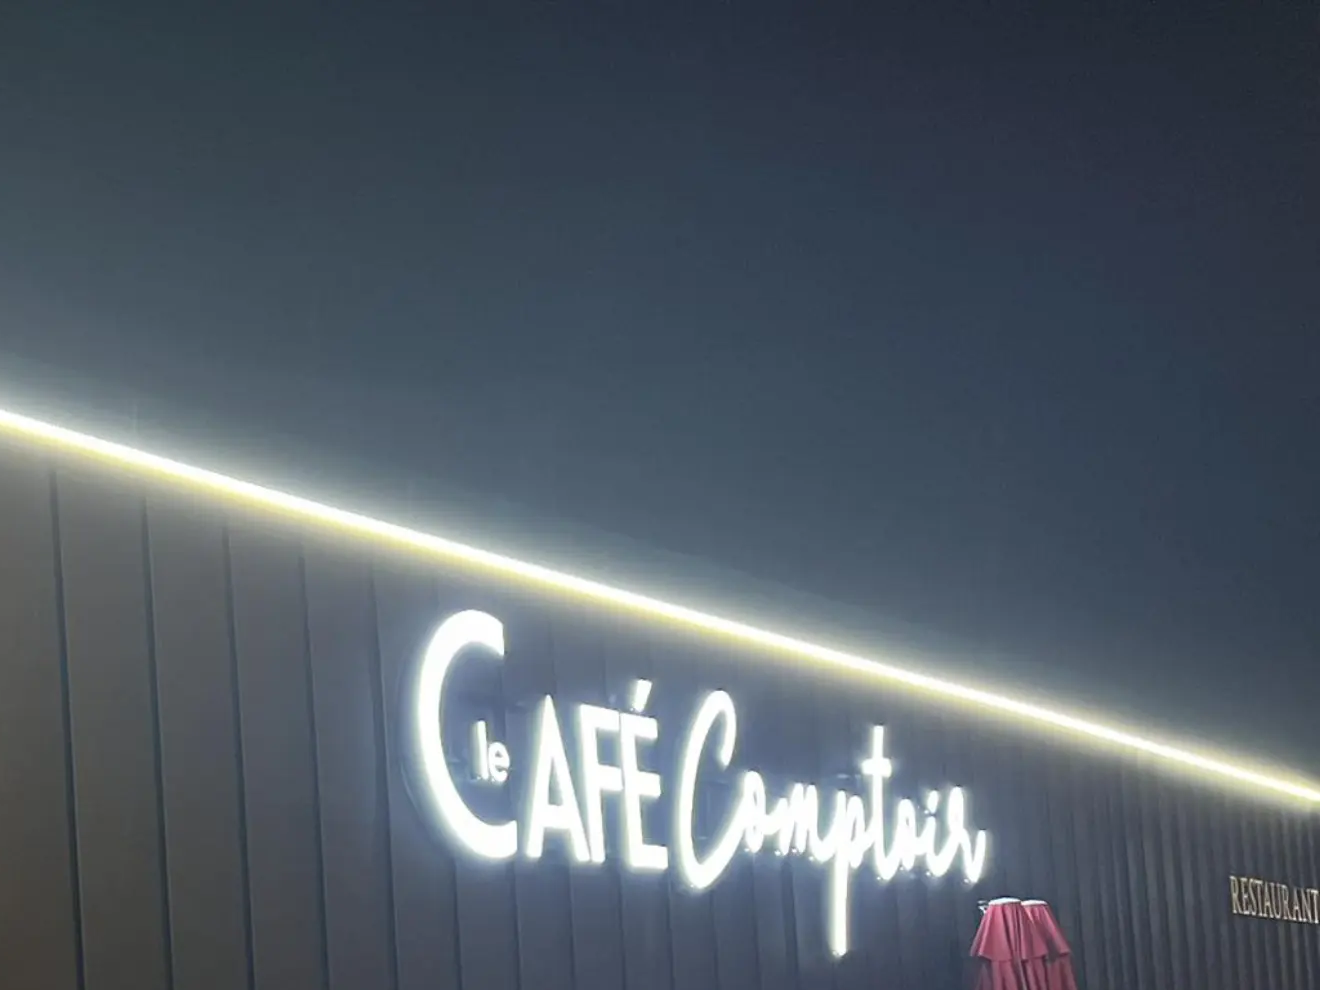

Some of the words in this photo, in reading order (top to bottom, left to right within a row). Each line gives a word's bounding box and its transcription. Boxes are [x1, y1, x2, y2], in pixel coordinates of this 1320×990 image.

[417, 608, 669, 871] CAFÉ
[680, 689, 987, 957] Comptoir
[474, 719, 511, 784] le
[1229, 875, 1320, 924] RESTAURANT
